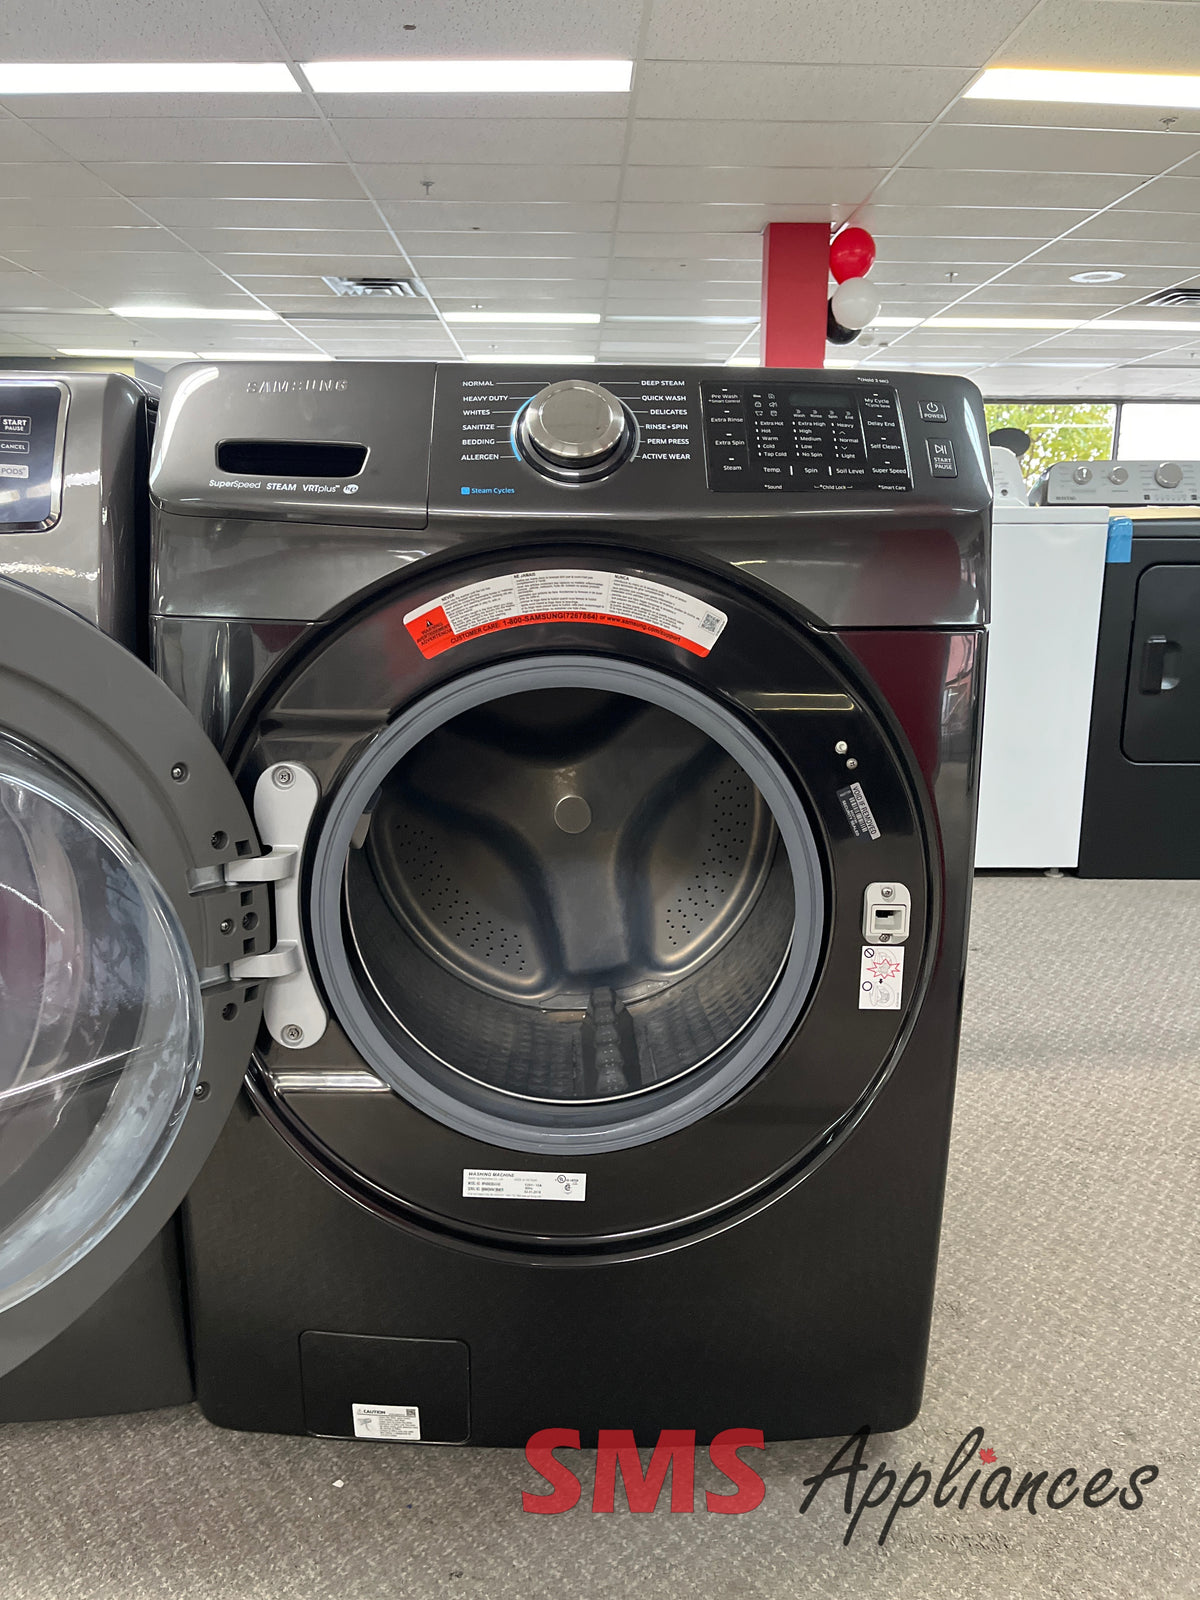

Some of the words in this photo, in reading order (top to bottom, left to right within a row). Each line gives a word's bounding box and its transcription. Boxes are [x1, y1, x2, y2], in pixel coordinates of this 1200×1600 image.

[246, 380, 348, 393] SAMSUNG
[209, 479, 261, 489] SuperSpeed
[266, 482, 297, 491] STEAM
[493, 487, 515, 495] Cycles
[450, 628, 482, 644] CUSTOMER
[483, 622, 499, 632] CARE
[853, 786, 863, 801] VOID
[862, 806, 877, 834] REMOVED
